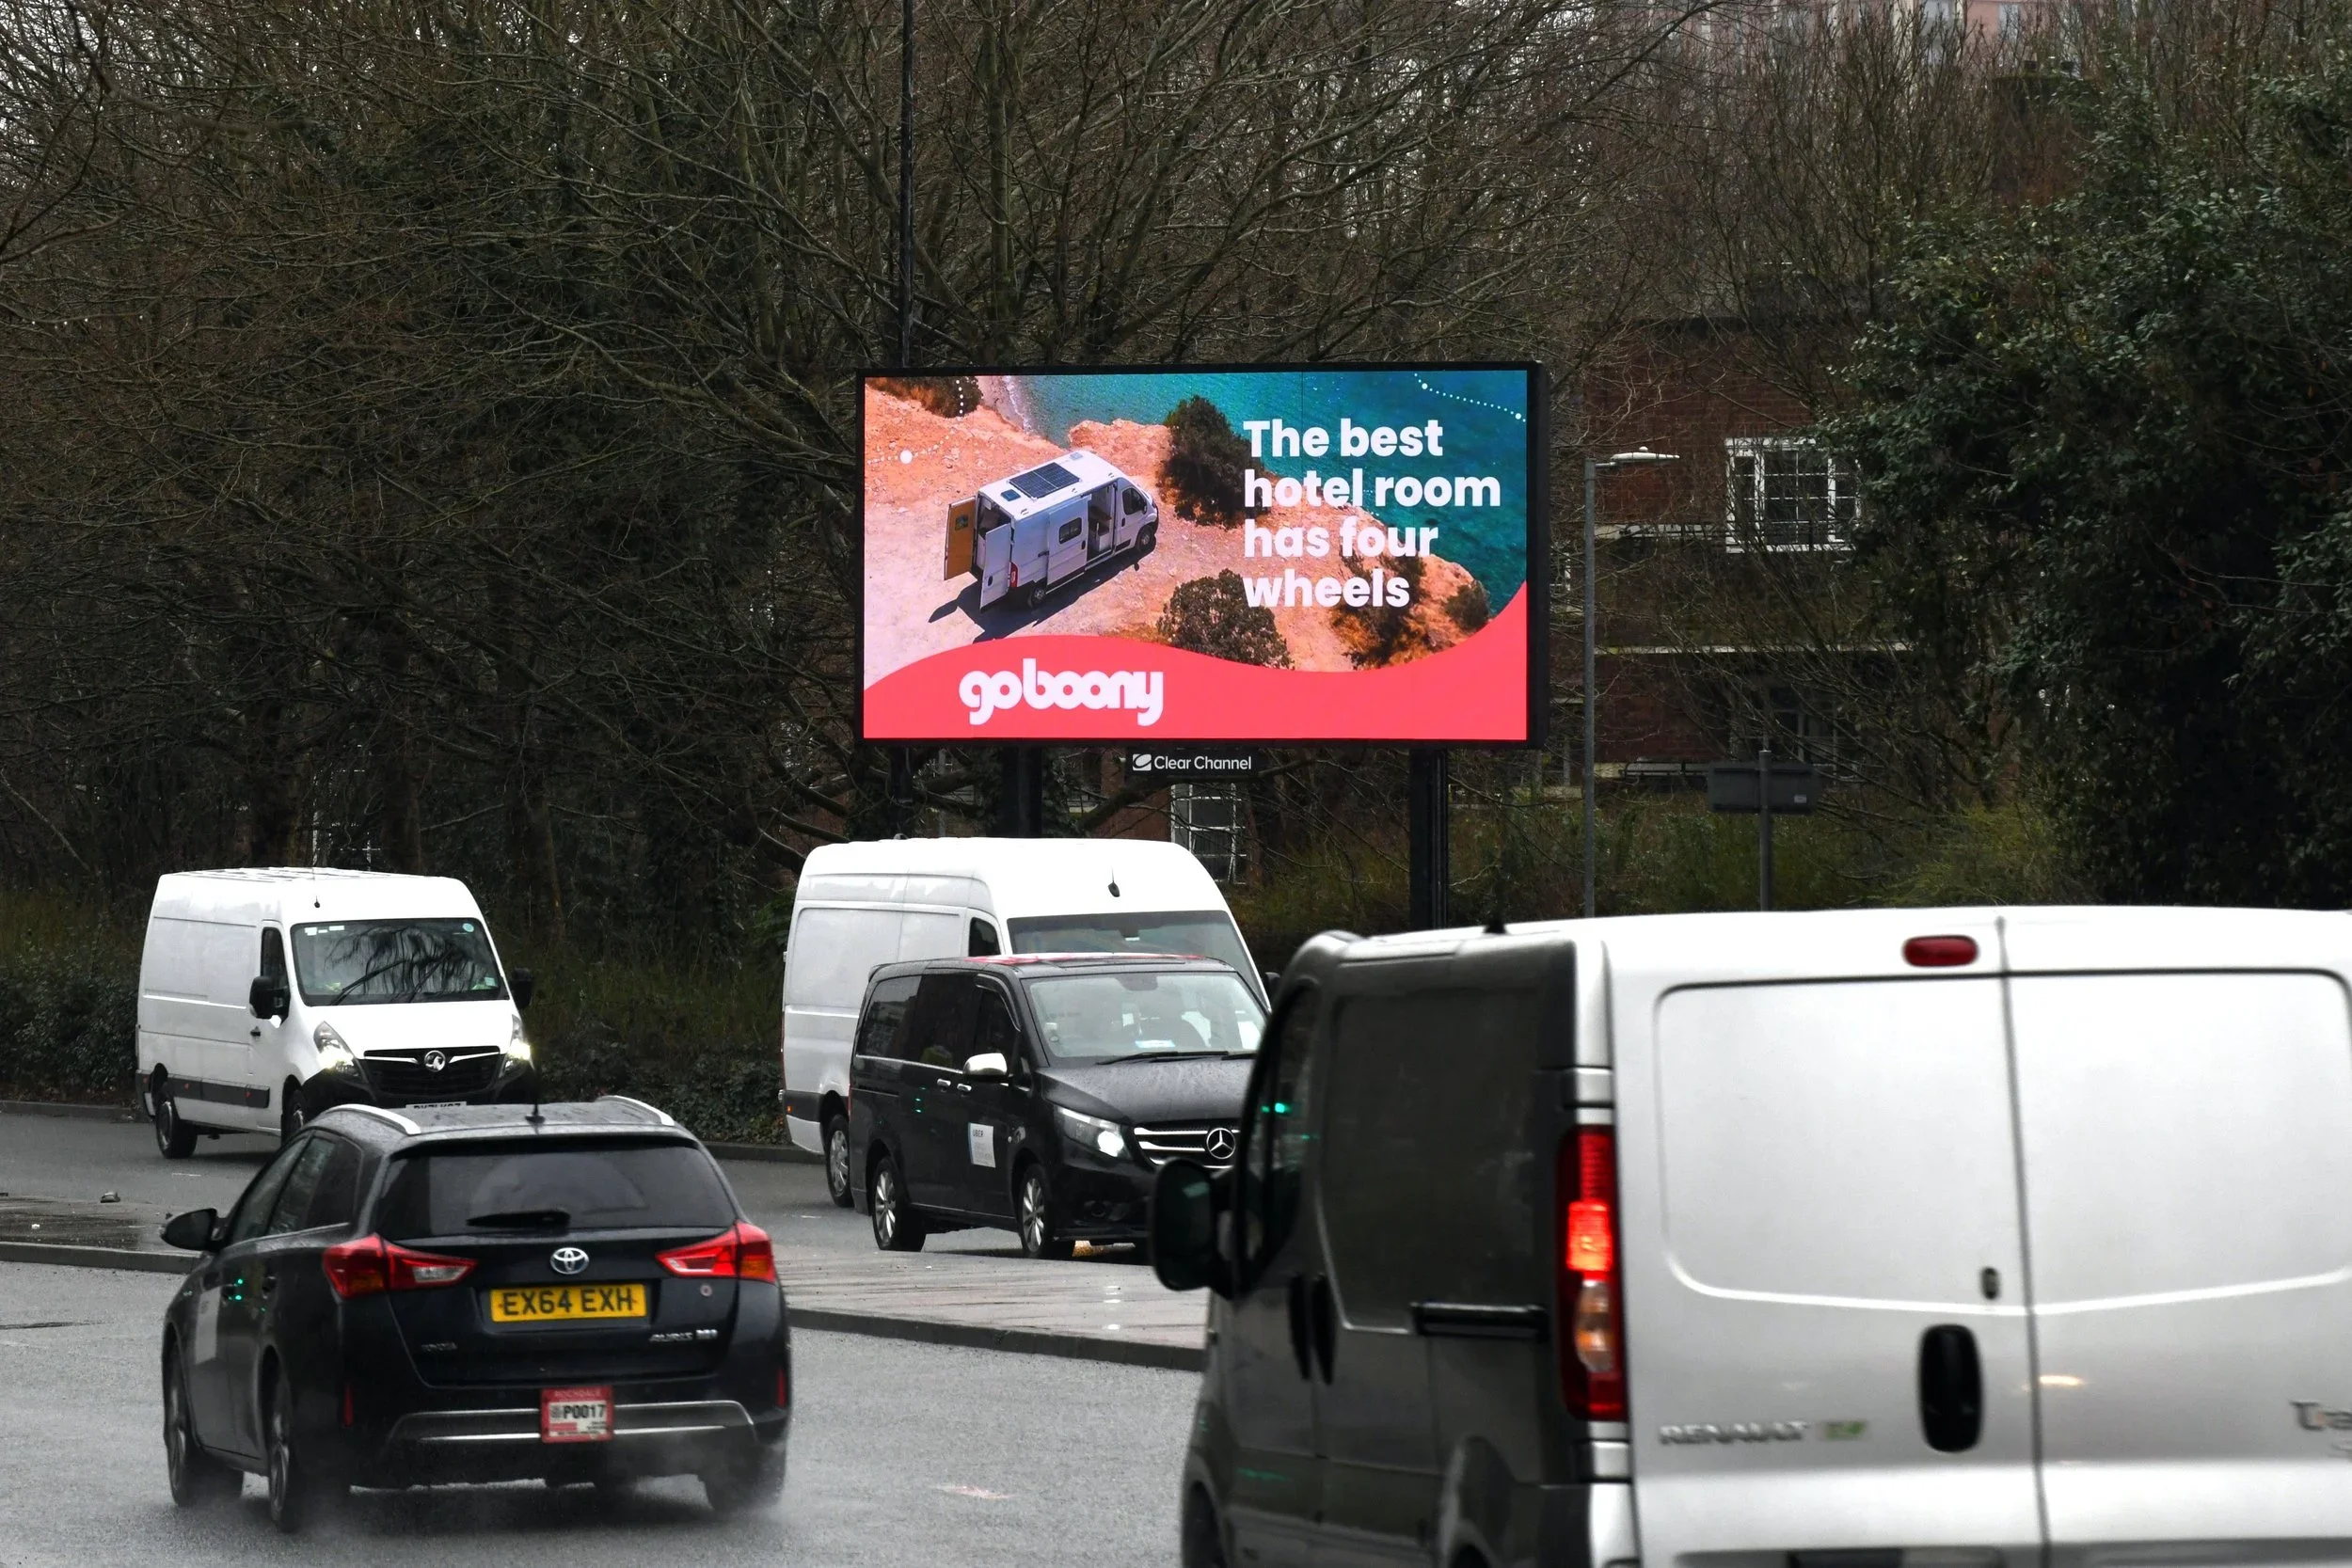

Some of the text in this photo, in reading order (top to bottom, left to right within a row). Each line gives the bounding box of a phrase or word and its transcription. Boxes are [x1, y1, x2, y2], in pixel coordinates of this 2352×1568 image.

[1244, 419, 1443, 457] The best
[1244, 468, 1501, 508] hotel room
[1244, 516, 1438, 558] has four
[1243, 568, 1410, 608] wheels
[959, 658, 1164, 726] goboony
[1153, 755, 1252, 769] Clear Channel
[502, 1287, 633, 1316] EX64 EXH
[1659, 1421, 1806, 1446] RENAULT
